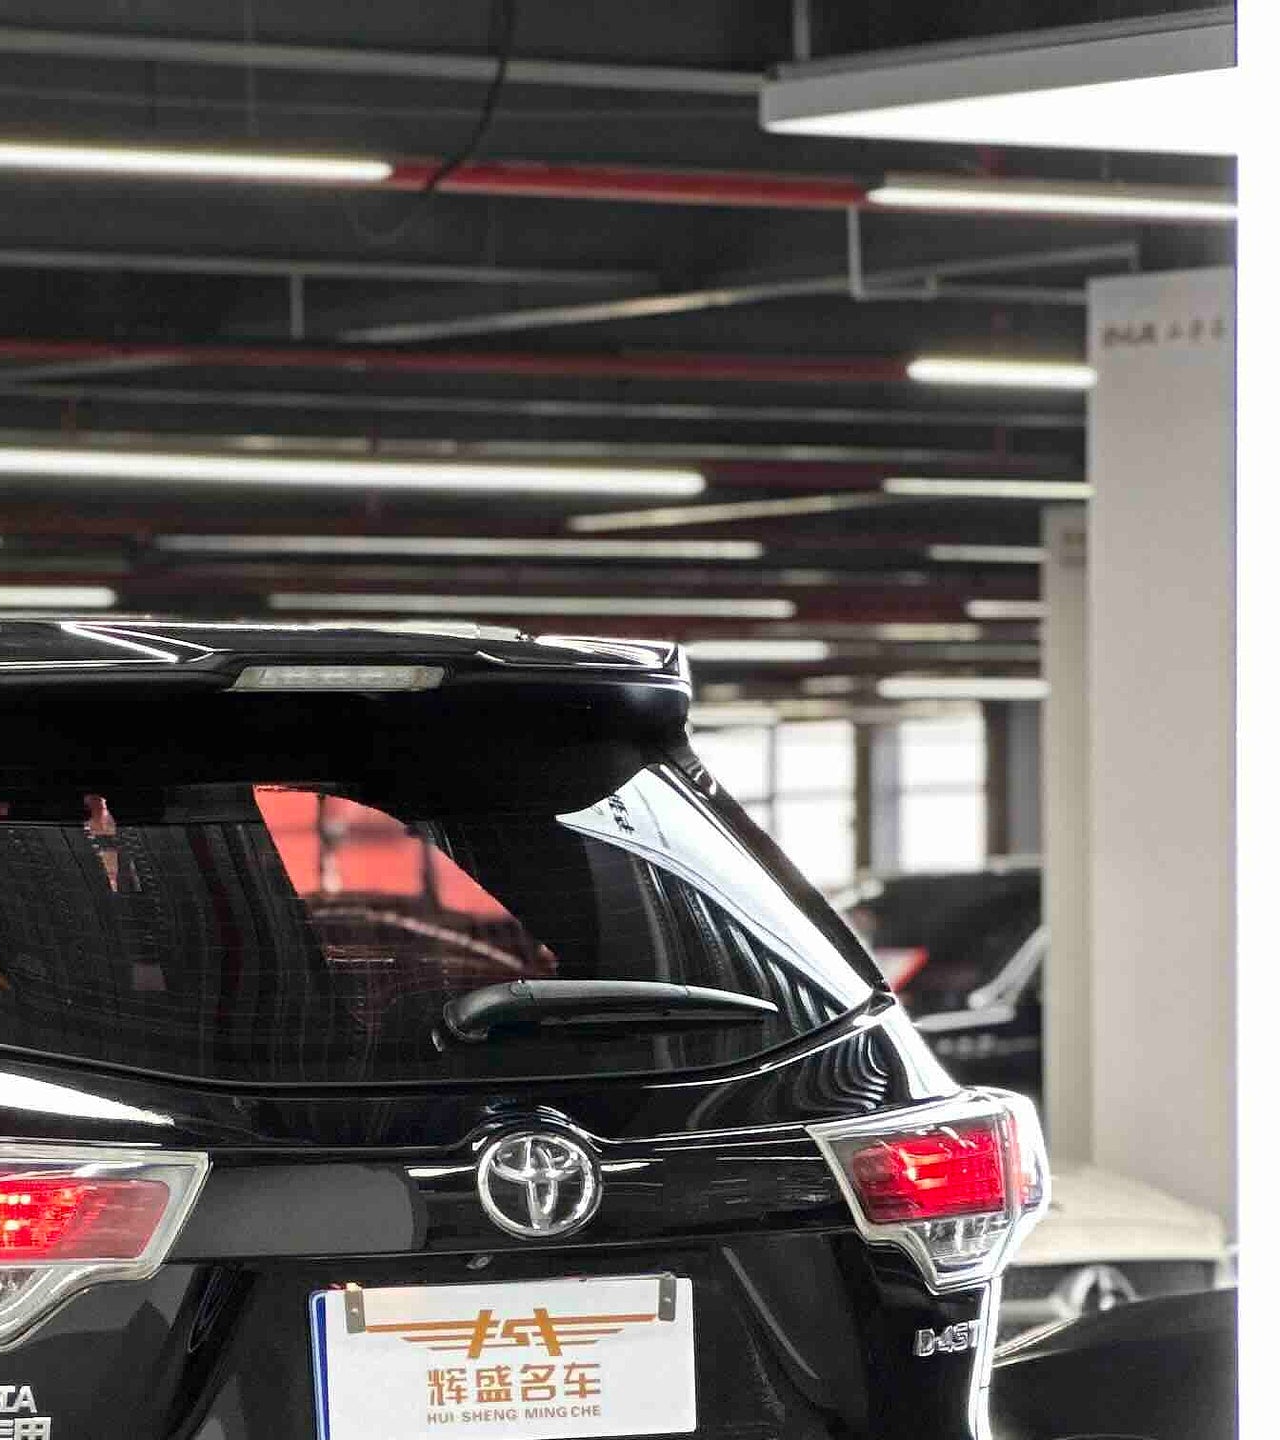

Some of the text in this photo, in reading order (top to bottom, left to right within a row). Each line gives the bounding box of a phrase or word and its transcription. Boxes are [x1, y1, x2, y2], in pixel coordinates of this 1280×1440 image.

[427, 1362, 601, 1406] 辉盛名车
[427, 1404, 602, 1425] HUI SHENG MING CHE
